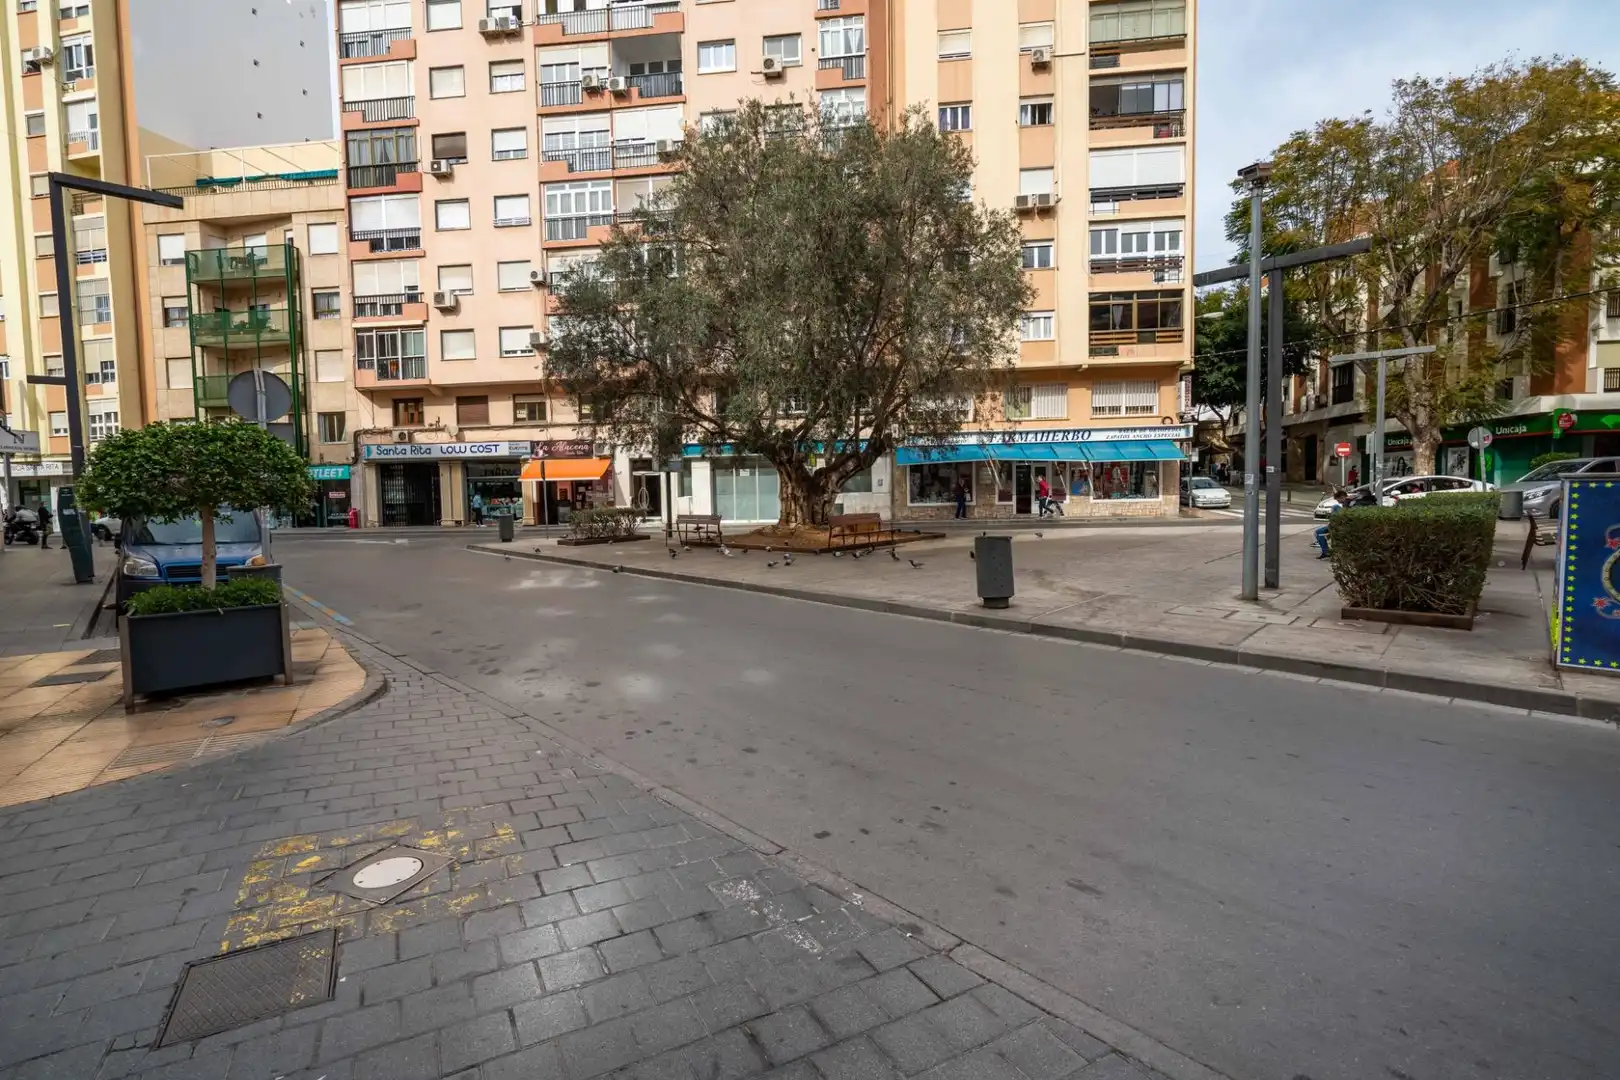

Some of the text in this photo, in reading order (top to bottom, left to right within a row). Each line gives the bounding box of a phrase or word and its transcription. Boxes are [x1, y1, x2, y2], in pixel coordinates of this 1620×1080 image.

[1495, 424, 1527, 434] Unicaja
[376, 444, 501, 456] Santa Rita LOW COST
